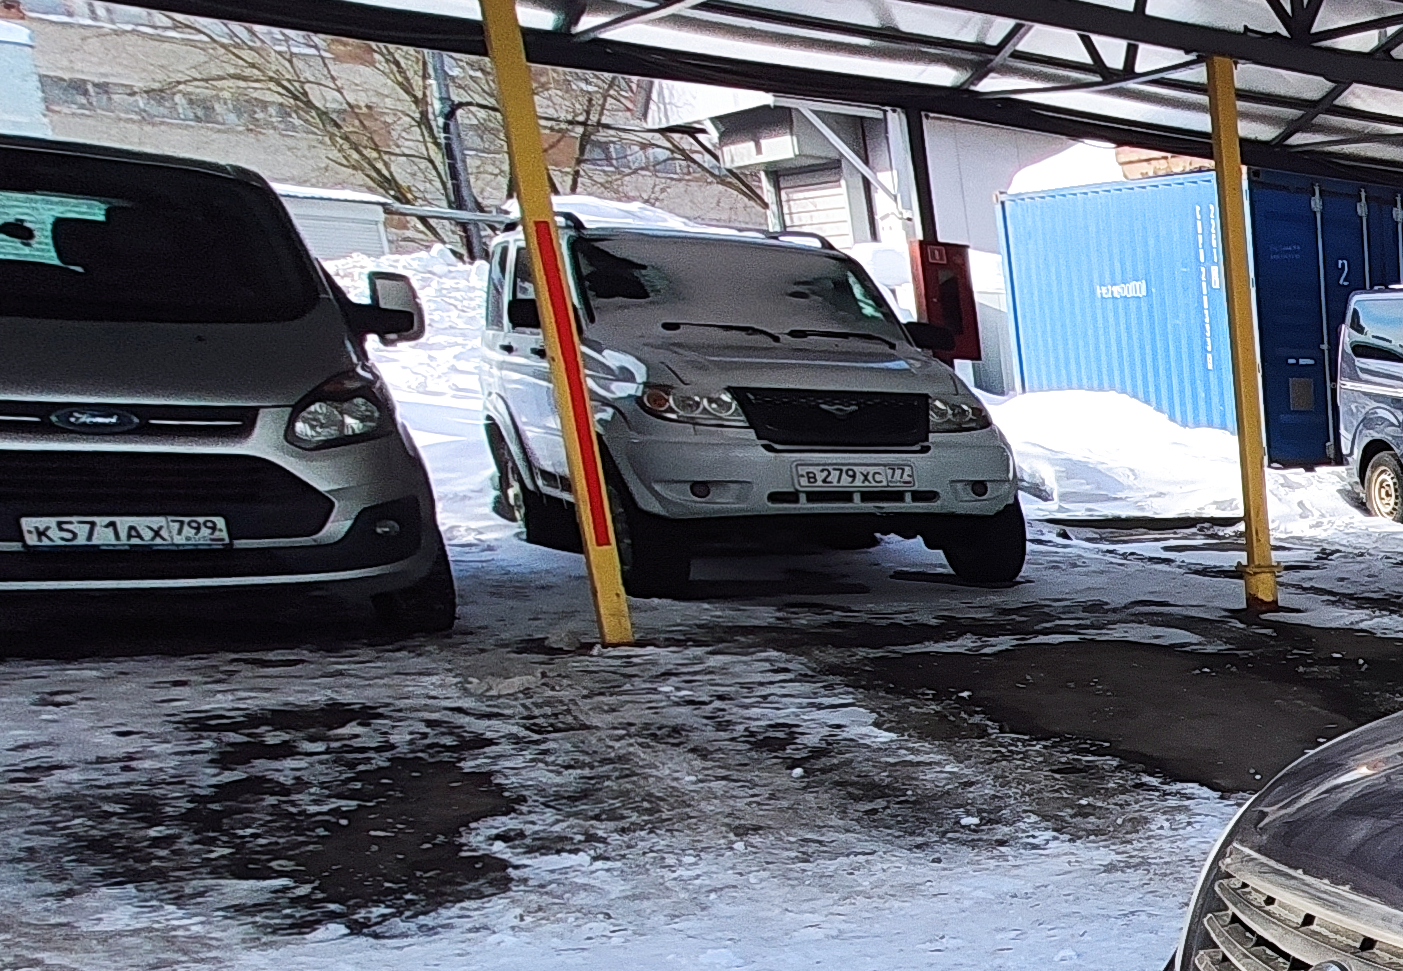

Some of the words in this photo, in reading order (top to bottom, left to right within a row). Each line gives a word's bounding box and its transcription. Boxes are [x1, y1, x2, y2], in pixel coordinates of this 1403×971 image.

[1337, 259, 1350, 286] 2
[805, 467, 884, 484] В279ХС
[887, 467, 906, 480] 77
[33, 519, 168, 542] К571АХ
[170, 519, 218, 536] 799
